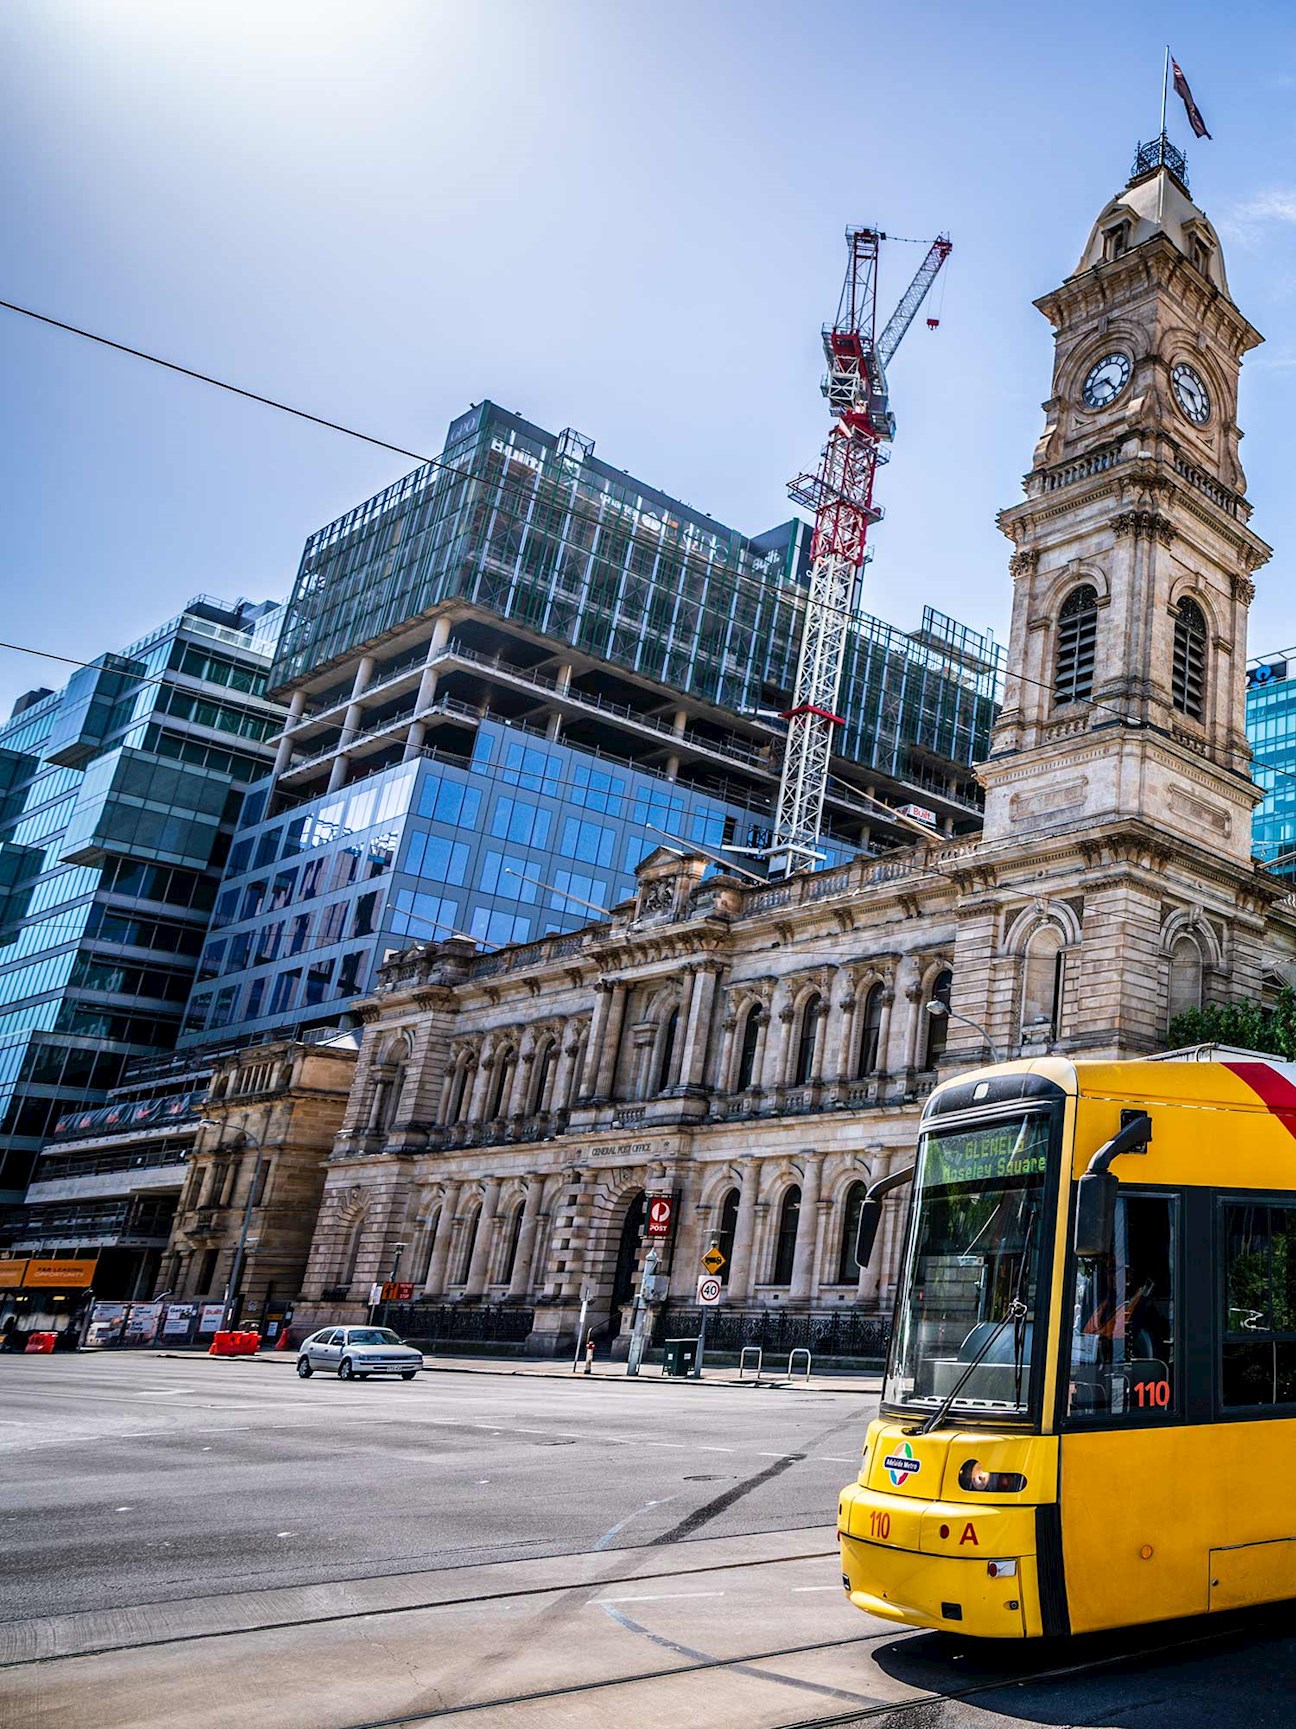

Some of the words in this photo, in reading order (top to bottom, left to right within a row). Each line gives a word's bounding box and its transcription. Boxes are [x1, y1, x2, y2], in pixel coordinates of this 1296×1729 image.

[450, 417, 476, 442] GPO
[592, 1146, 617, 1157] GENERAL
[617, 1144, 632, 1154] POST
[632, 1142, 652, 1153] OFFICE
[942, 1160, 992, 1184] Moseley
[997, 1156, 1046, 1177] Square
[704, 1285, 717, 1296] 40
[1134, 1381, 1170, 1407] 110
[886, 1459, 903, 1468] Adelaide
[903, 1461, 918, 1470] Metro
[870, 1511, 891, 1539] 110
[959, 1522, 979, 1546] A
